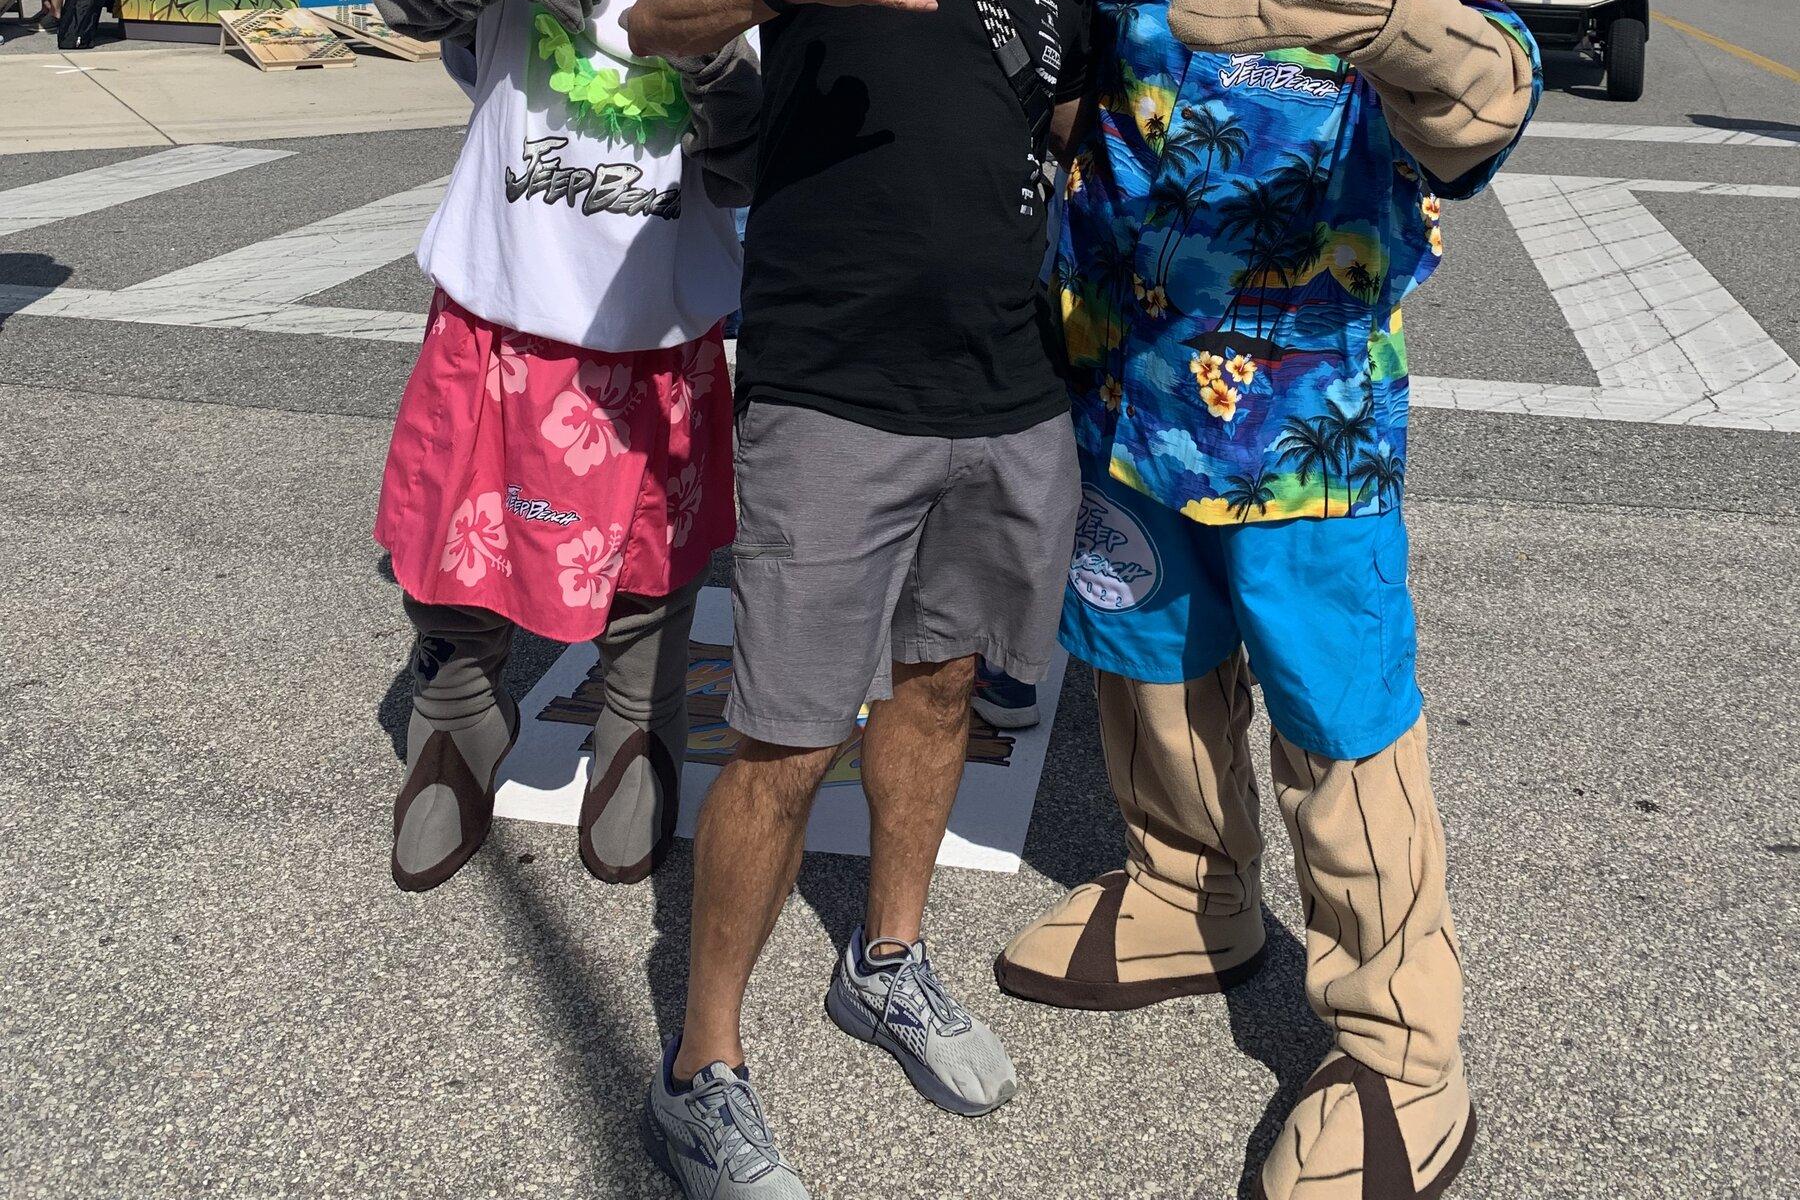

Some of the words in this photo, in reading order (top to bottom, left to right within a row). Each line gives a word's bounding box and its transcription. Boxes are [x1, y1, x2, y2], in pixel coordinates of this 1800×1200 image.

[1218, 52, 1276, 89] JEEP
[1269, 63, 1341, 97] BEACH
[505, 136, 594, 208] JEEP
[526, 500, 582, 527] BEACH
[1074, 572, 1123, 608] 2022
